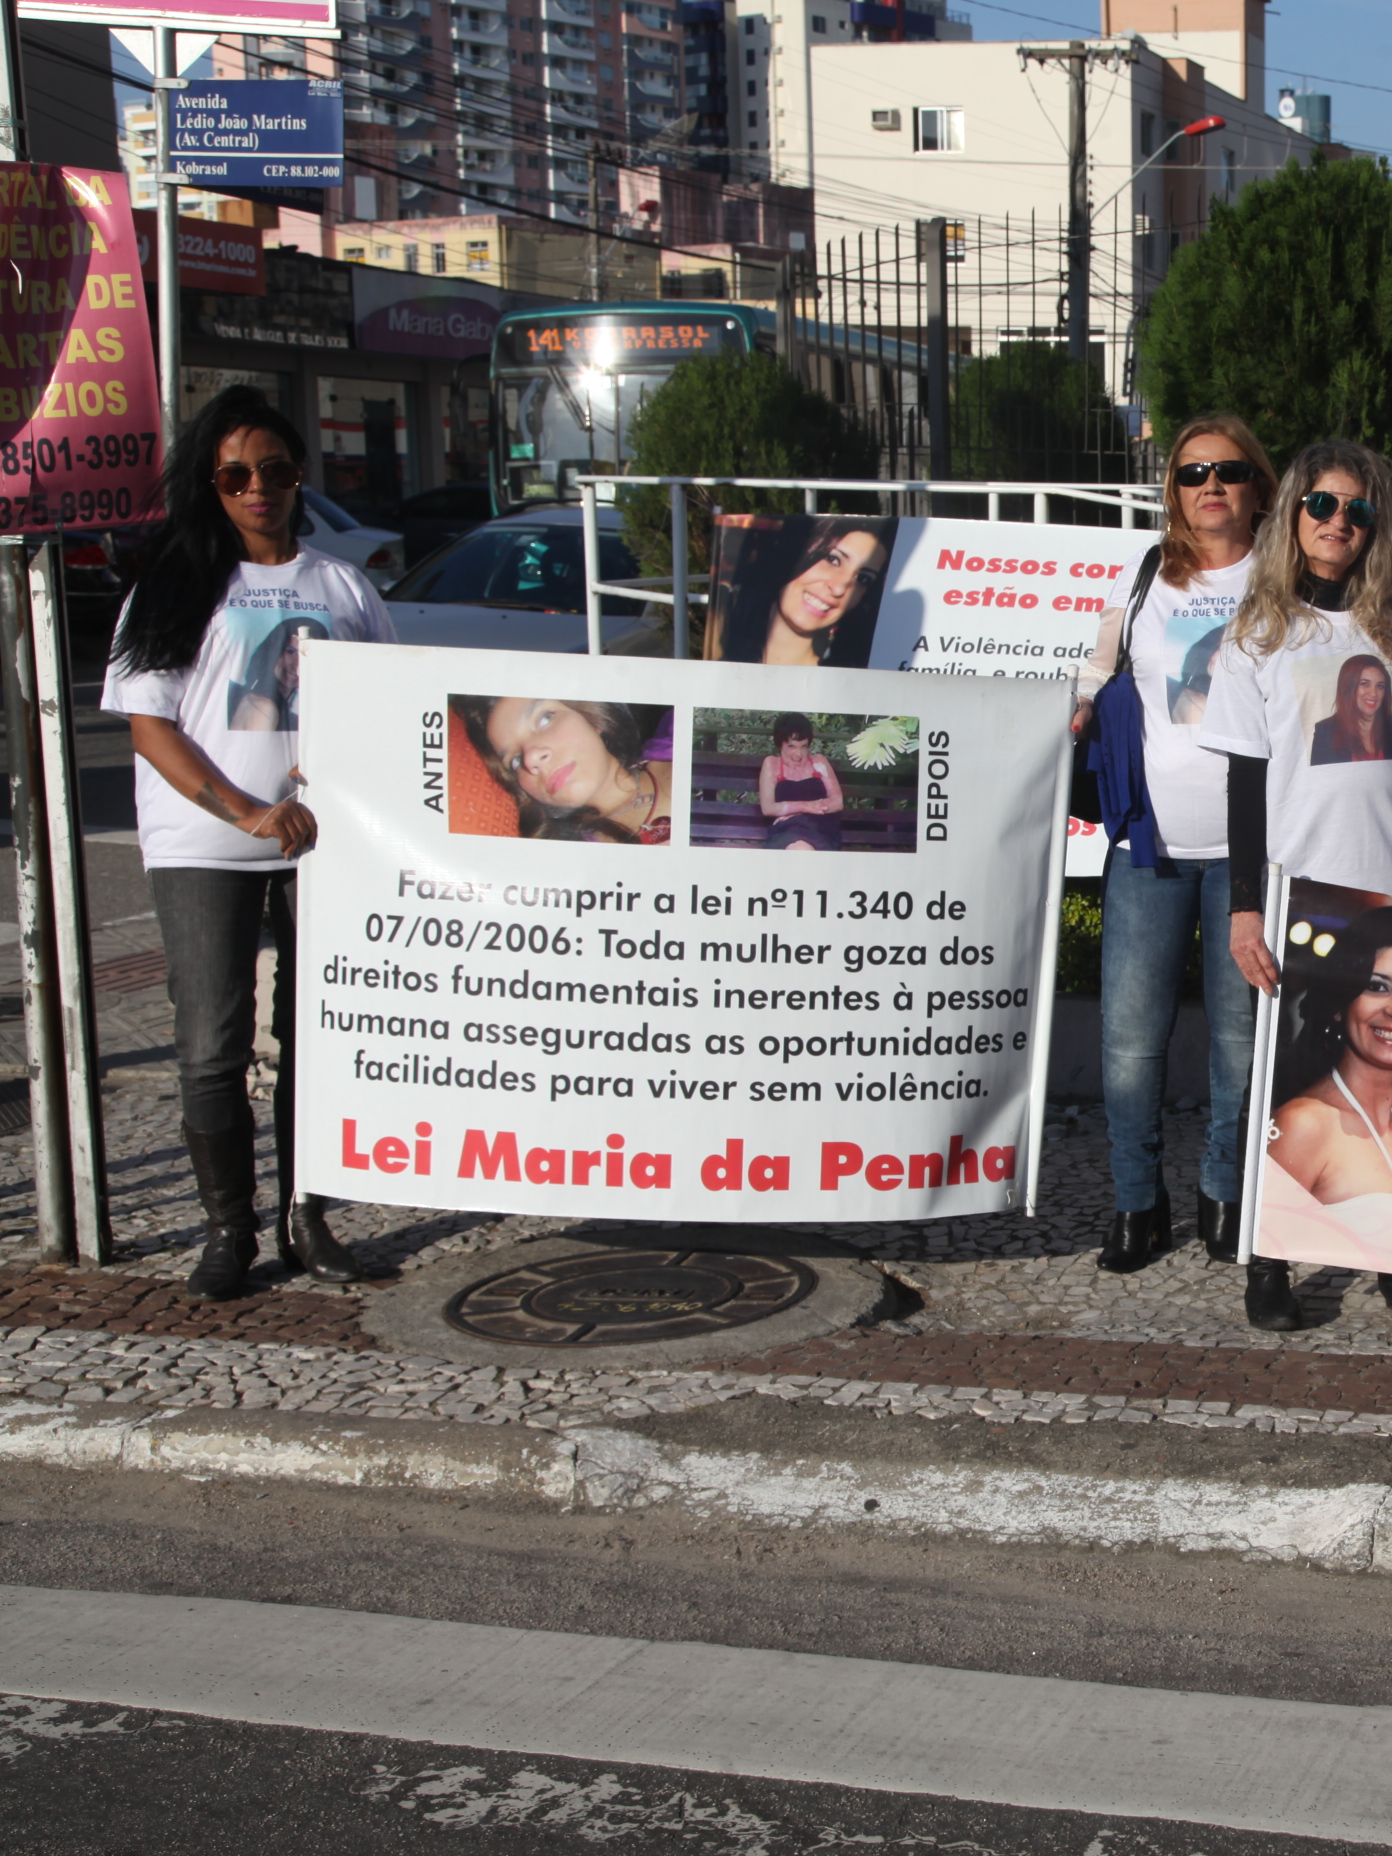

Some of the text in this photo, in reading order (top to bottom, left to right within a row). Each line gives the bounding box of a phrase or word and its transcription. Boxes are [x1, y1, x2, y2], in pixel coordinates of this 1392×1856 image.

[308, 79, 342, 89] ACRIL
[175, 94, 228, 109] Avenida
[176, 113, 307, 130] Lédio João Martins
[175, 131, 259, 151] (Av. Central)
[176, 161, 340, 178] Kobrasol CEP: 88.102-000
[86, 273, 136, 310] DE
[526, 328, 564, 352] 141
[936, 548, 1058, 576] Nossos
[240, 599, 247, 608] O
[251, 599, 274, 608] QUE
[278, 599, 291, 610] SE
[294, 601, 330, 612] BUSCA
[244, 588, 300, 599] JUSTIÇA
[942, 586, 1039, 610] estão
[1188, 596, 1236, 607] JUSTIÇA
[1173, 607, 1179, 617] É
[1182, 610, 1189, 618] O
[1191, 608, 1211, 617] QUE
[1214, 607, 1226, 616] SE
[912, 635, 930, 652] A
[939, 636, 1045, 657] Violência
[422, 710, 444, 814] ANTES
[926, 730, 950, 842] DEPOIS
[397, 869, 492, 903] Fazer
[503, 881, 642, 918] cumprir
[653, 893, 676, 914] a
[691, 884, 732, 916] lei
[926, 890, 967, 921] de
[364, 913, 995, 973] 07/08/2006: Toda mulher goza dos
[323, 955, 1029, 1019] direitos fundamentais inerentes à pessoa
[320, 999, 1027, 1064] humana asseguradas as oportunidades e
[354, 1049, 989, 1102] facilidades para viver sem violência.
[341, 1117, 1016, 1192] Lei Maria da Penha
